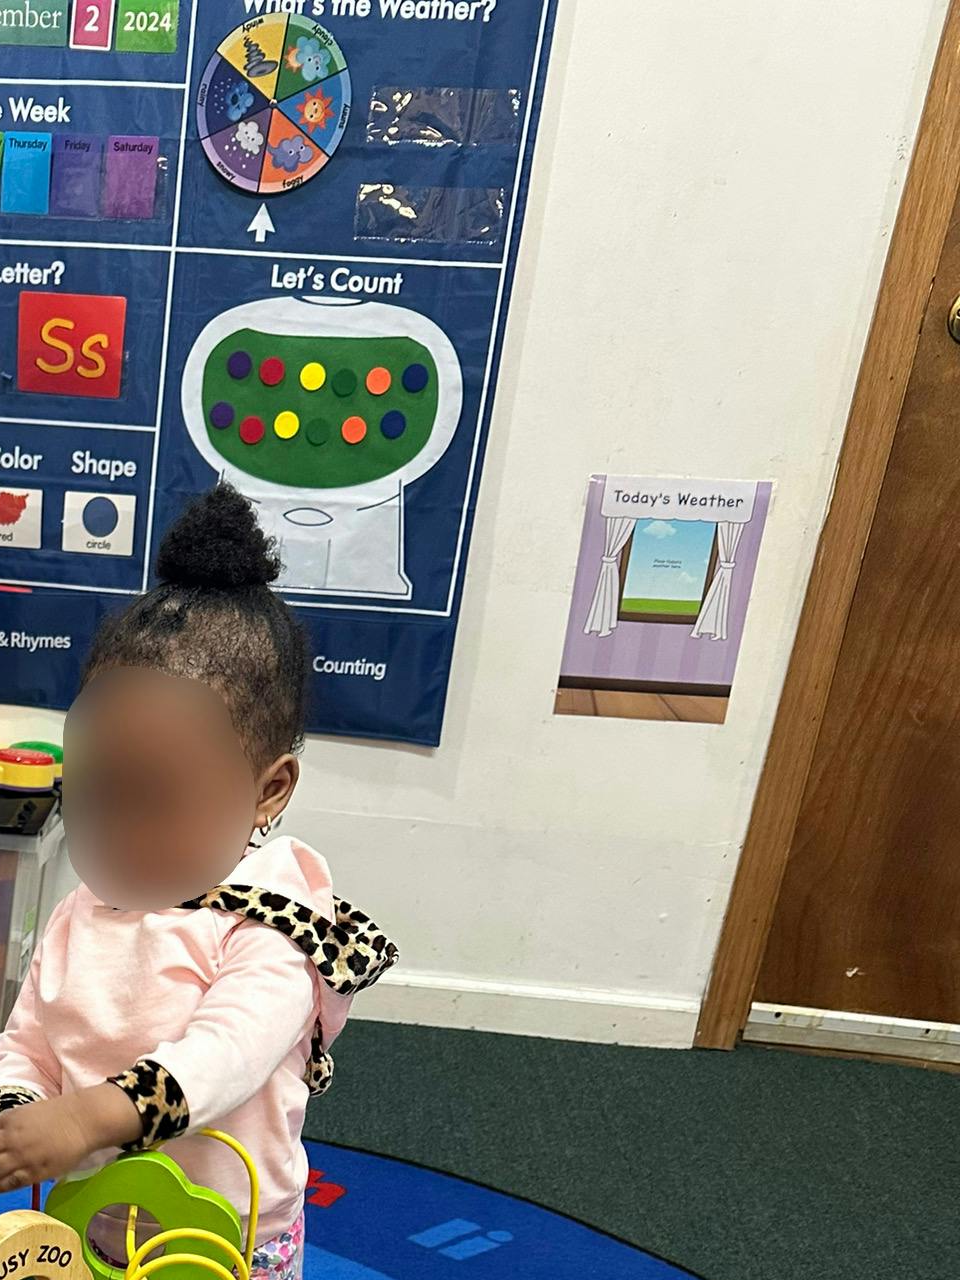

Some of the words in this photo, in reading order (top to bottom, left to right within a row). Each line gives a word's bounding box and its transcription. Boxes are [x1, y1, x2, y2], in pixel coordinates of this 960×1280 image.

[85, 5, 99, 32] 2
[243, 0, 324, 16] Whats
[123, 11, 172, 32] 2024
[242, 18, 264, 33] windy
[311, 24, 333, 46] cloudy
[197, 83, 208, 108] rainy
[8, 98, 71, 123] Week
[339, 103, 352, 129] sunny
[9, 138, 47, 152] Thursday
[64, 139, 91, 152] Friday
[113, 141, 153, 154] Saturday
[216, 161, 237, 181] snowy
[282, 175, 304, 189] foggy
[271, 264, 325, 291] Let's
[330, 268, 403, 294] Count
[36, 318, 109, 378] Ss
[71, 450, 137, 480] Shape
[614, 490, 670, 507] Today's
[678, 492, 744, 508] Weather
[86, 539, 111, 551] circle
[11, 632, 71, 650] Rhymes
[313, 656, 386, 679] Counting
[37, 1245, 72, 1268] ZOO
